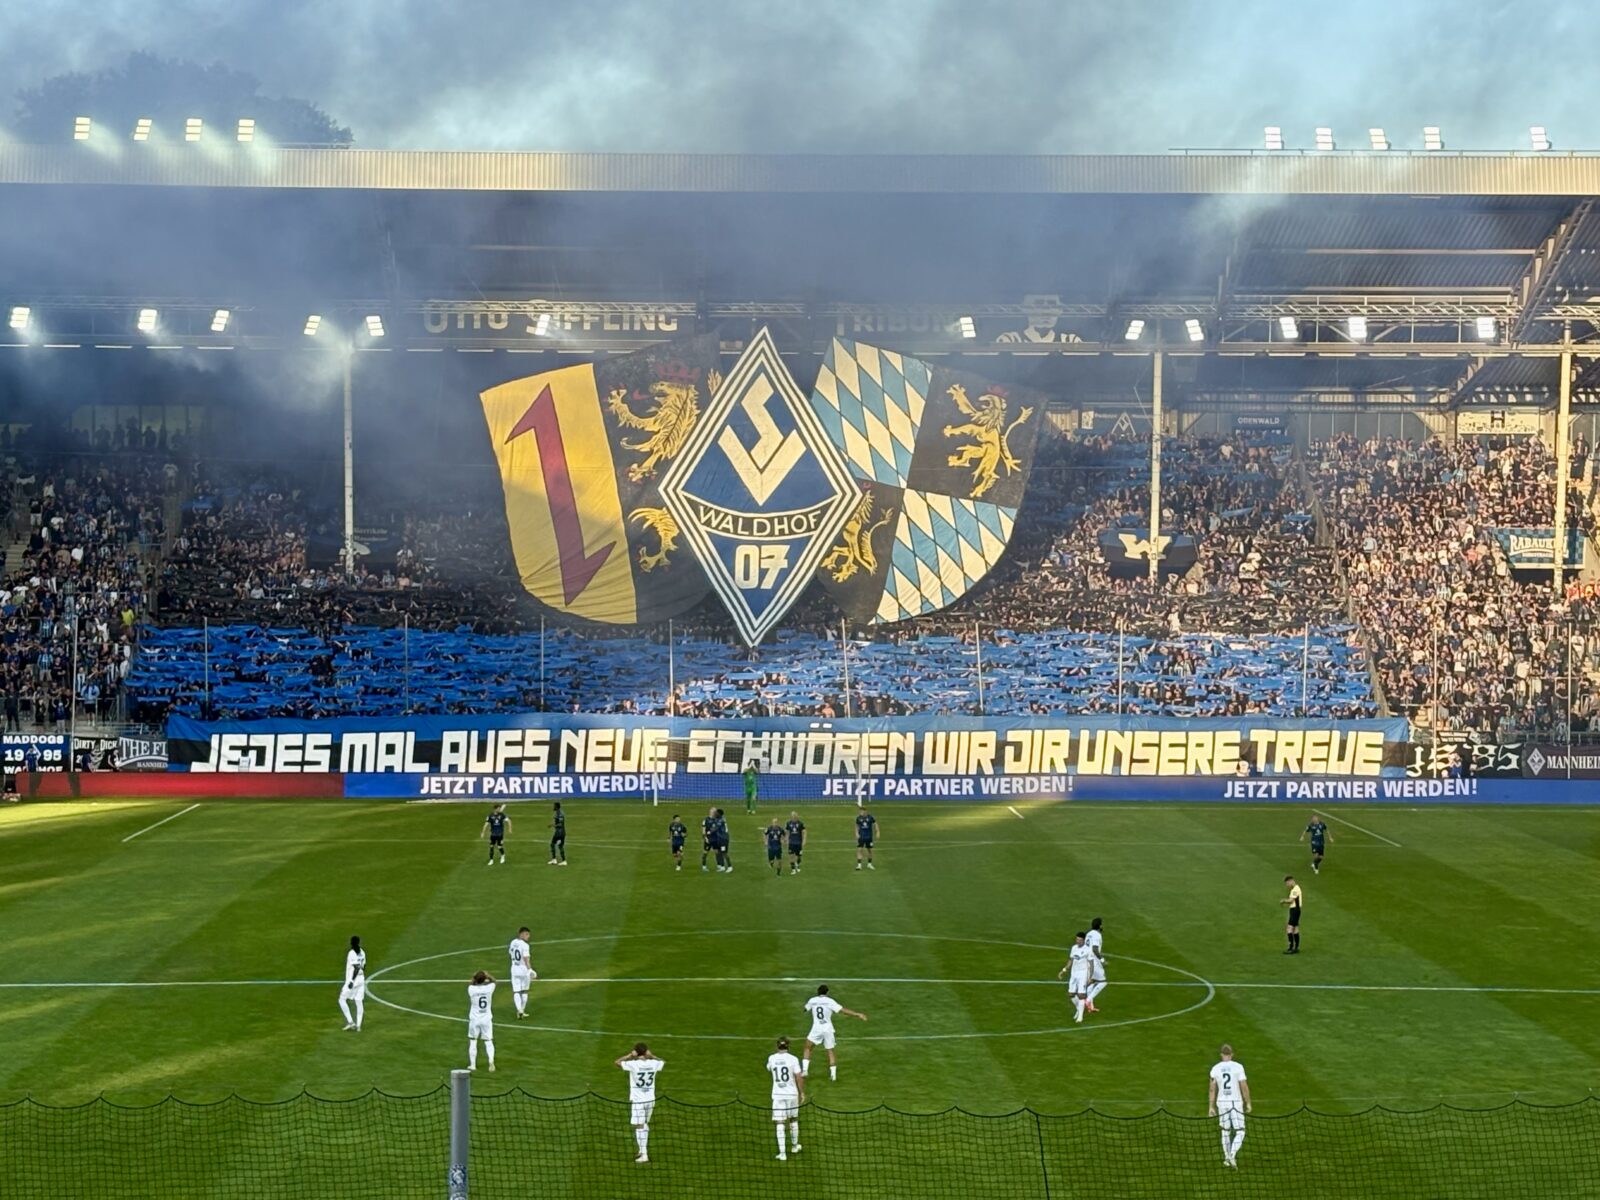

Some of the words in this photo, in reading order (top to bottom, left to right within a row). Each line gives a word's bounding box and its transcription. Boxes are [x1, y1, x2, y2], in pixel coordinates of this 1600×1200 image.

[423, 300, 508, 333] OTTO
[699, 505, 822, 537] WALDHOF
[734, 544, 791, 589] 07
[3, 735, 64, 744] MADDOGS
[74, 738, 96, 750] DIRTY
[4, 749, 25, 761] 19
[43, 749, 62, 761] 95
[119, 737, 149, 761] THE
[152, 741, 168, 756] FI
[190, 733, 332, 773] JEDES
[340, 731, 429, 773] MAL
[441, 729, 551, 773] AUFS
[559, 729, 676, 774] NEUE
[687, 723, 915, 774] SCHWÖREN
[923, 731, 997, 775] WIR
[1004, 729, 1071, 775] DIR
[1077, 729, 1242, 776] UNSERE
[1250, 729, 1384, 776] TREUE
[4, 766, 63, 774] WAHOF
[420, 777, 476, 794] JETZT
[483, 776, 573, 794] PARTNER
[579, 774, 673, 793] WERDEN!
[822, 778, 878, 796] JETZT
[884, 778, 974, 796] PARTNER
[981, 776, 1074, 795] WERDEN!
[1224, 781, 1279, 798] JETZT
[1286, 780, 1377, 798] PARTNER
[1384, 778, 1478, 797] WERDEN!
[478, 996, 487, 1009] 6
[816, 1006, 825, 1020] 8
[636, 1072, 655, 1088] 33
[773, 1066, 790, 1083] 18
[1222, 1073, 1231, 1090] 2
